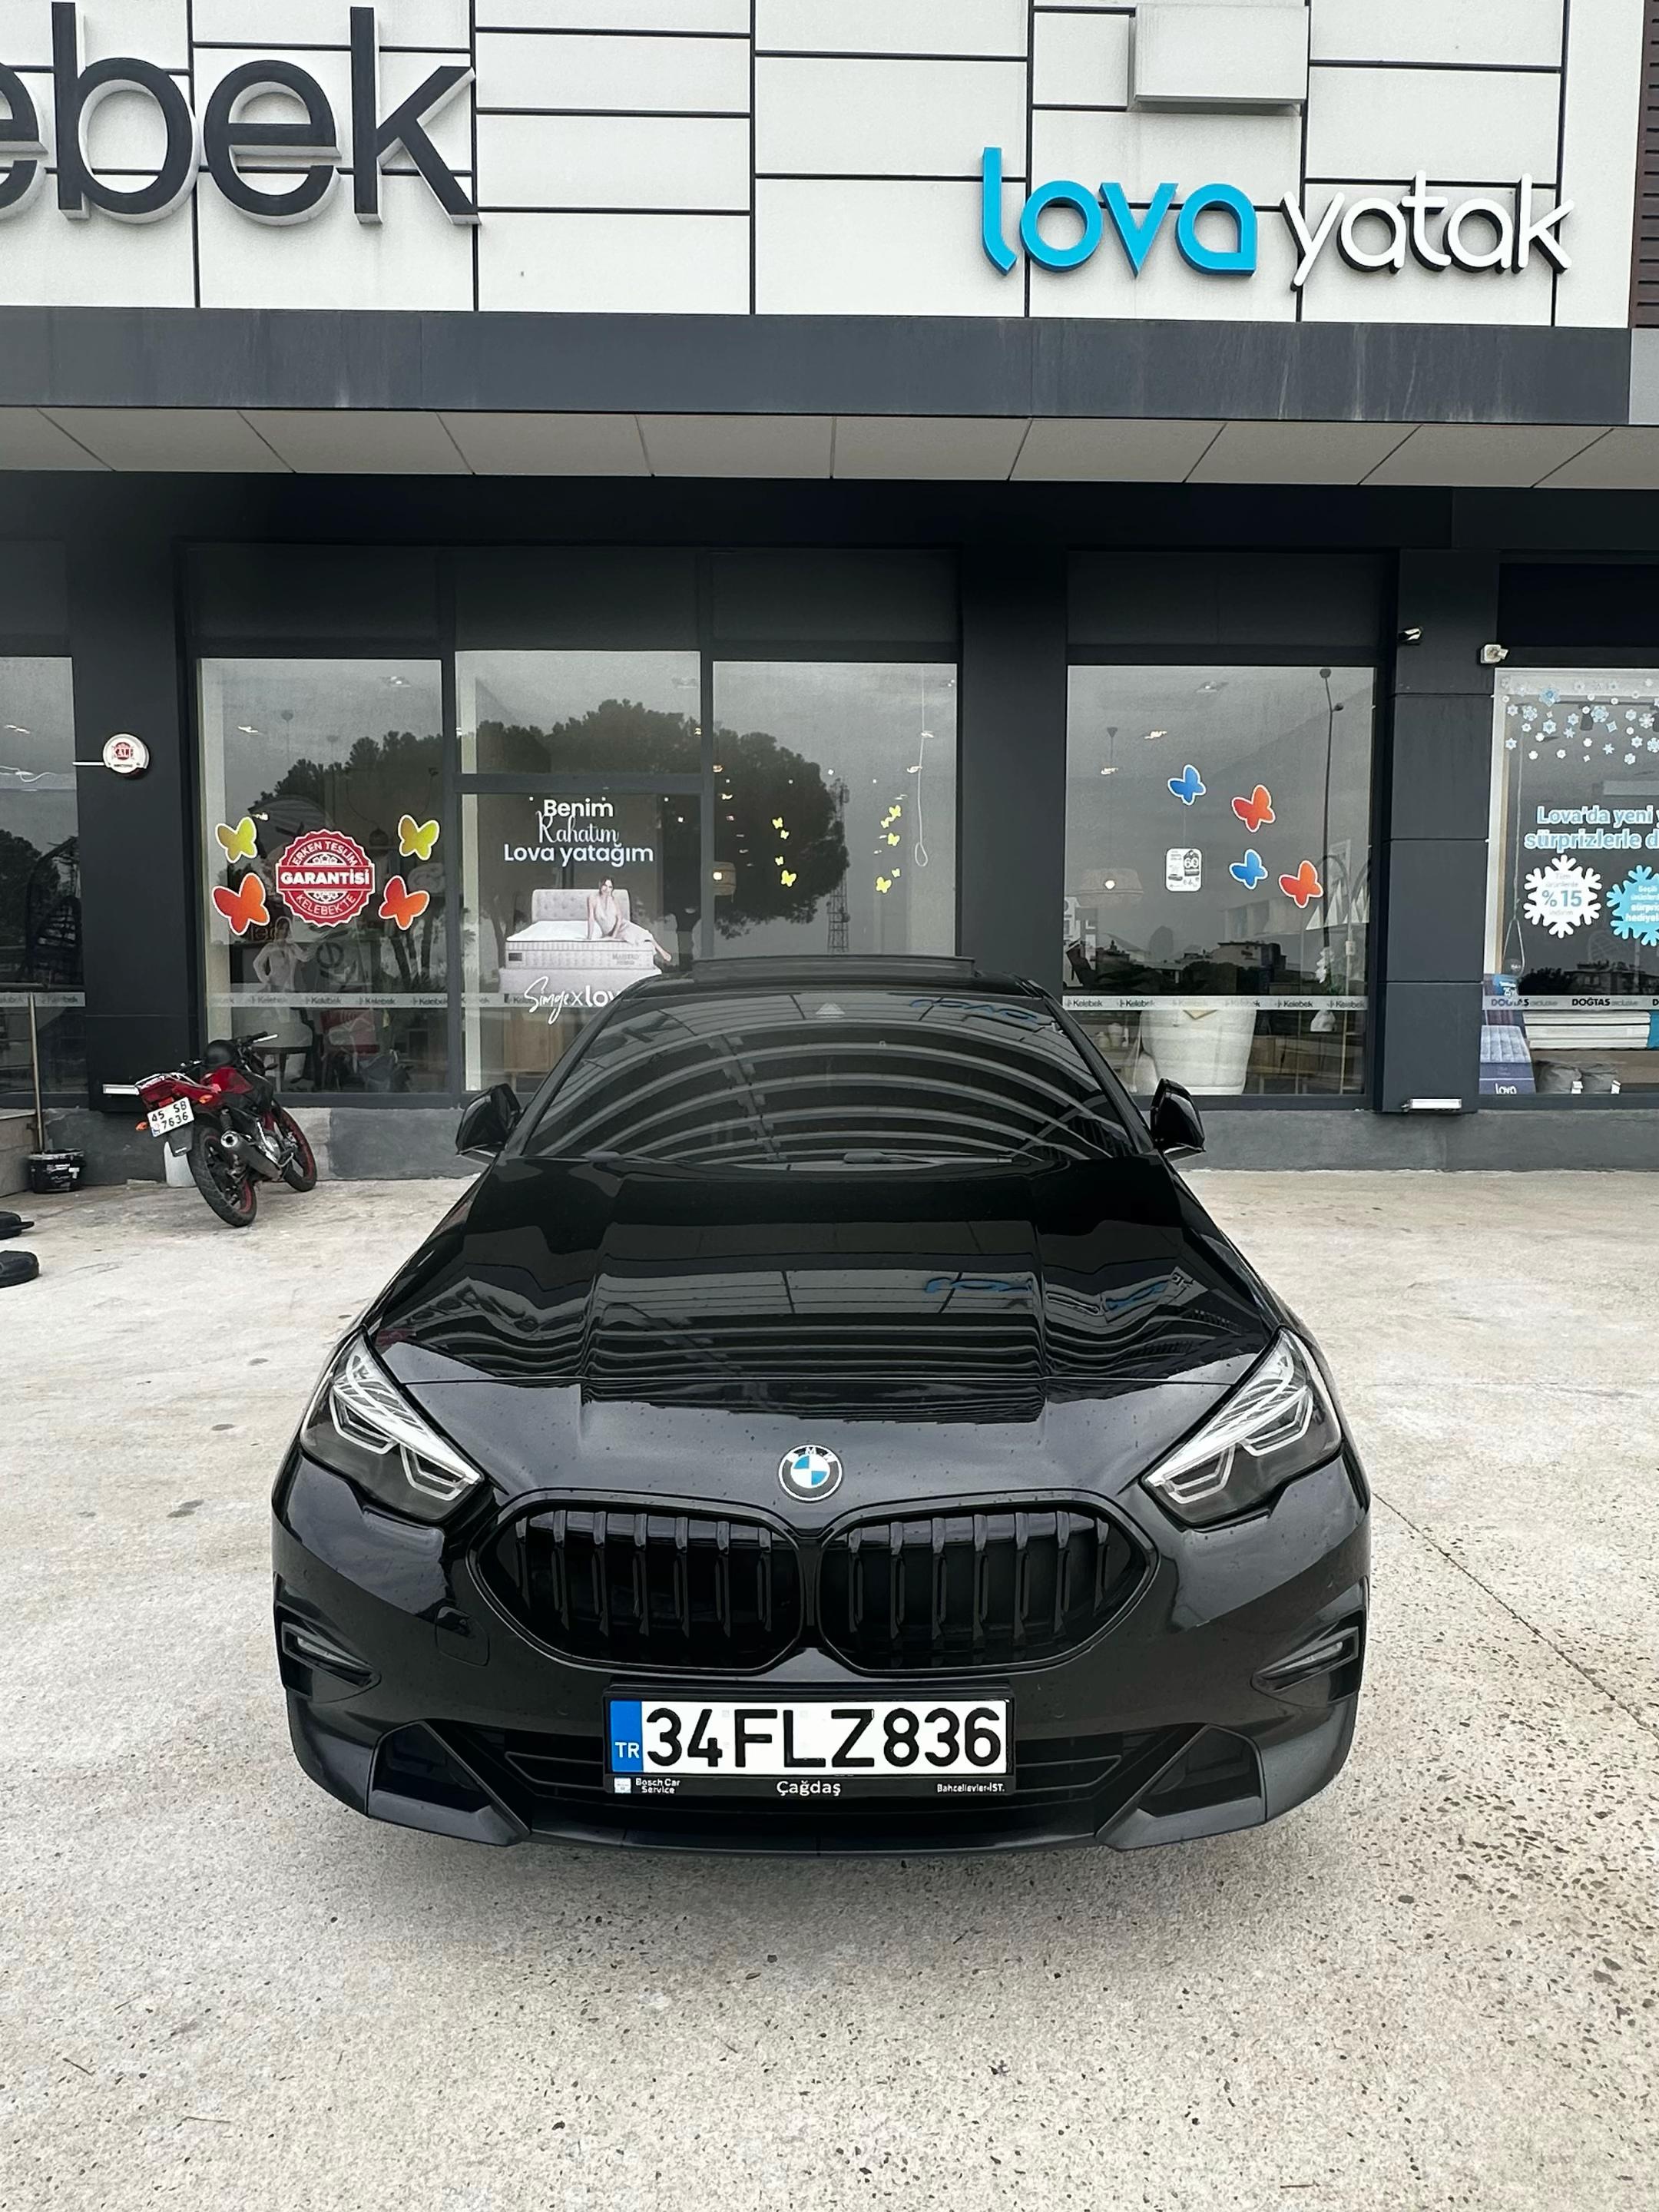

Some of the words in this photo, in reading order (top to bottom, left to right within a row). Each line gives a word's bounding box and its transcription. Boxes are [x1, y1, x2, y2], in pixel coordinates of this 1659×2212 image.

[982, 147, 1258, 277] lova
[1281, 169, 1575, 292] yatak
[543, 797, 614, 817] Benim
[1537, 805, 1611, 824] Lova'da
[1613, 805, 1654, 828] yeni
[1524, 828, 1642, 854] sürprizlerle
[292, 840, 323, 866] ERKEN
[324, 841, 359, 868] TESLİM
[504, 843, 555, 861] Lova
[559, 841, 653, 867] yatağım
[280, 868, 370, 885] GARANTİSİ
[151, 1110, 165, 1121] 45
[174, 1101, 187, 1113] SB
[161, 1112, 188, 1130] 7636
[615, 1741, 640, 1760] TR
[635, 1777, 663, 1786] Bosch
[664, 1778, 681, 1786] Car
[641, 1786, 675, 1794] Service
[776, 1780, 842, 1796] Çağdaş
